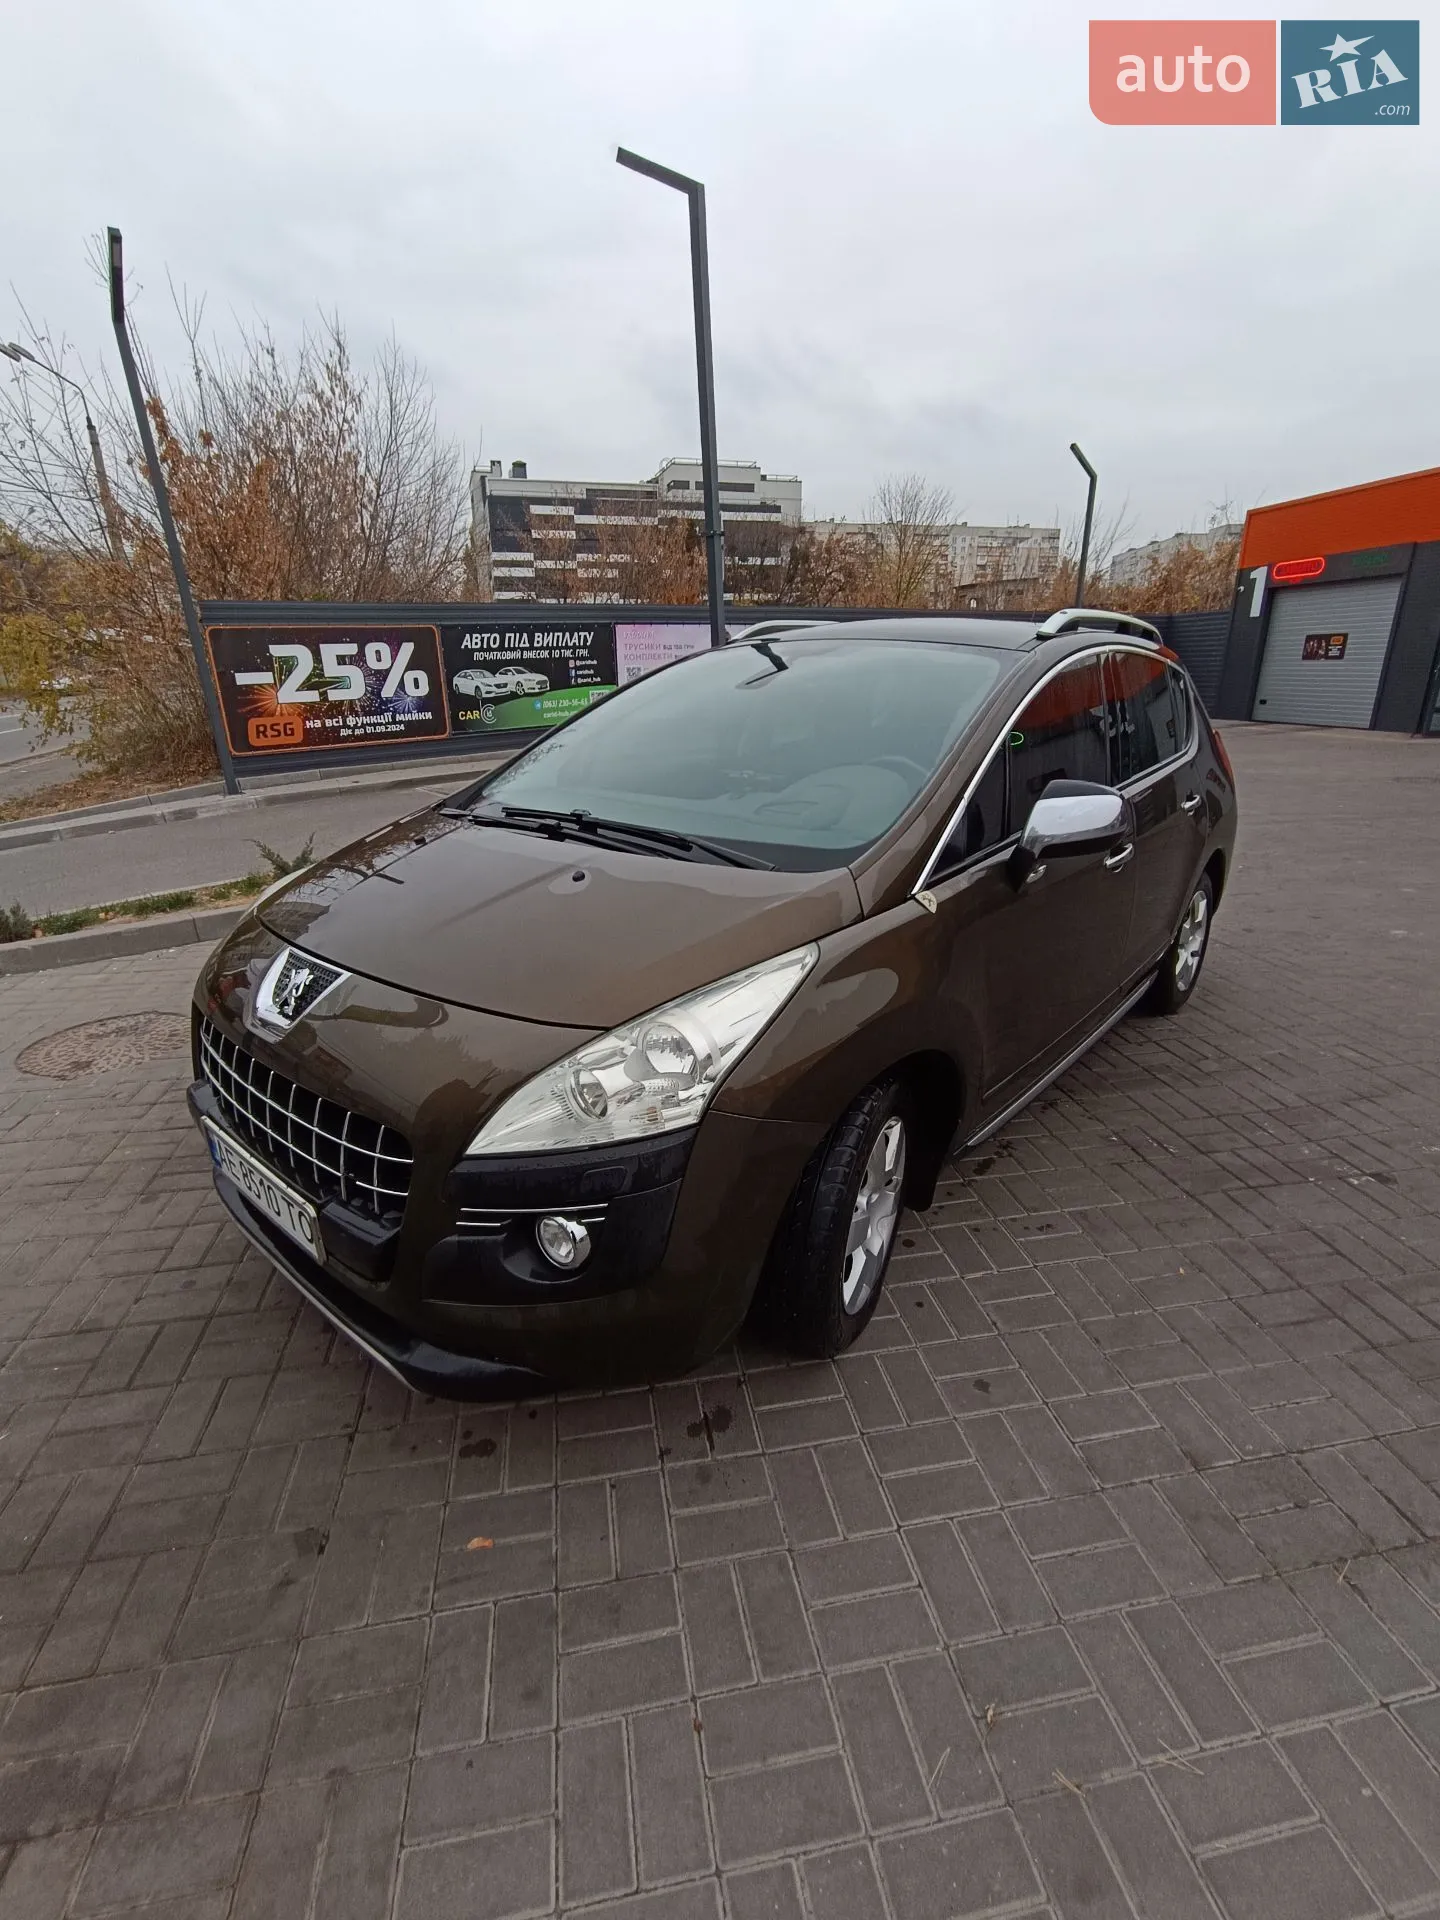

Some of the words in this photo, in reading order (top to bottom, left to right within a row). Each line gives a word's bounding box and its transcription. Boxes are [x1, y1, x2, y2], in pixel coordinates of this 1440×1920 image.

[1249, 566, 1268, 618] 1
[461, 633, 500, 649] АВТО
[504, 632, 530, 648] ПІД
[533, 631, 594, 647] ВИПЛАТУ
[624, 643, 661, 651] ТРУСИКИ
[473, 649, 521, 661] ПОЧАТКОВИЙ
[522, 649, 550, 659] ВНЕСОК
[551, 649, 560, 658] 10
[561, 649, 575, 658] ТИС.
[575, 648, 590, 657] ГРН.
[305, 719, 322, 729] на
[324, 715, 343, 727] всі
[346, 713, 393, 726] функції
[395, 710, 433, 721] мийки
[458, 710, 480, 720] CAR
[255, 721, 296, 740] RSG
[340, 727, 353, 737] Діє
[355, 727, 365, 736] до
[366, 724, 405, 734] 01.09.2024
[217, 1139, 241, 1182] AE
[240, 1160, 282, 1218] 8510
